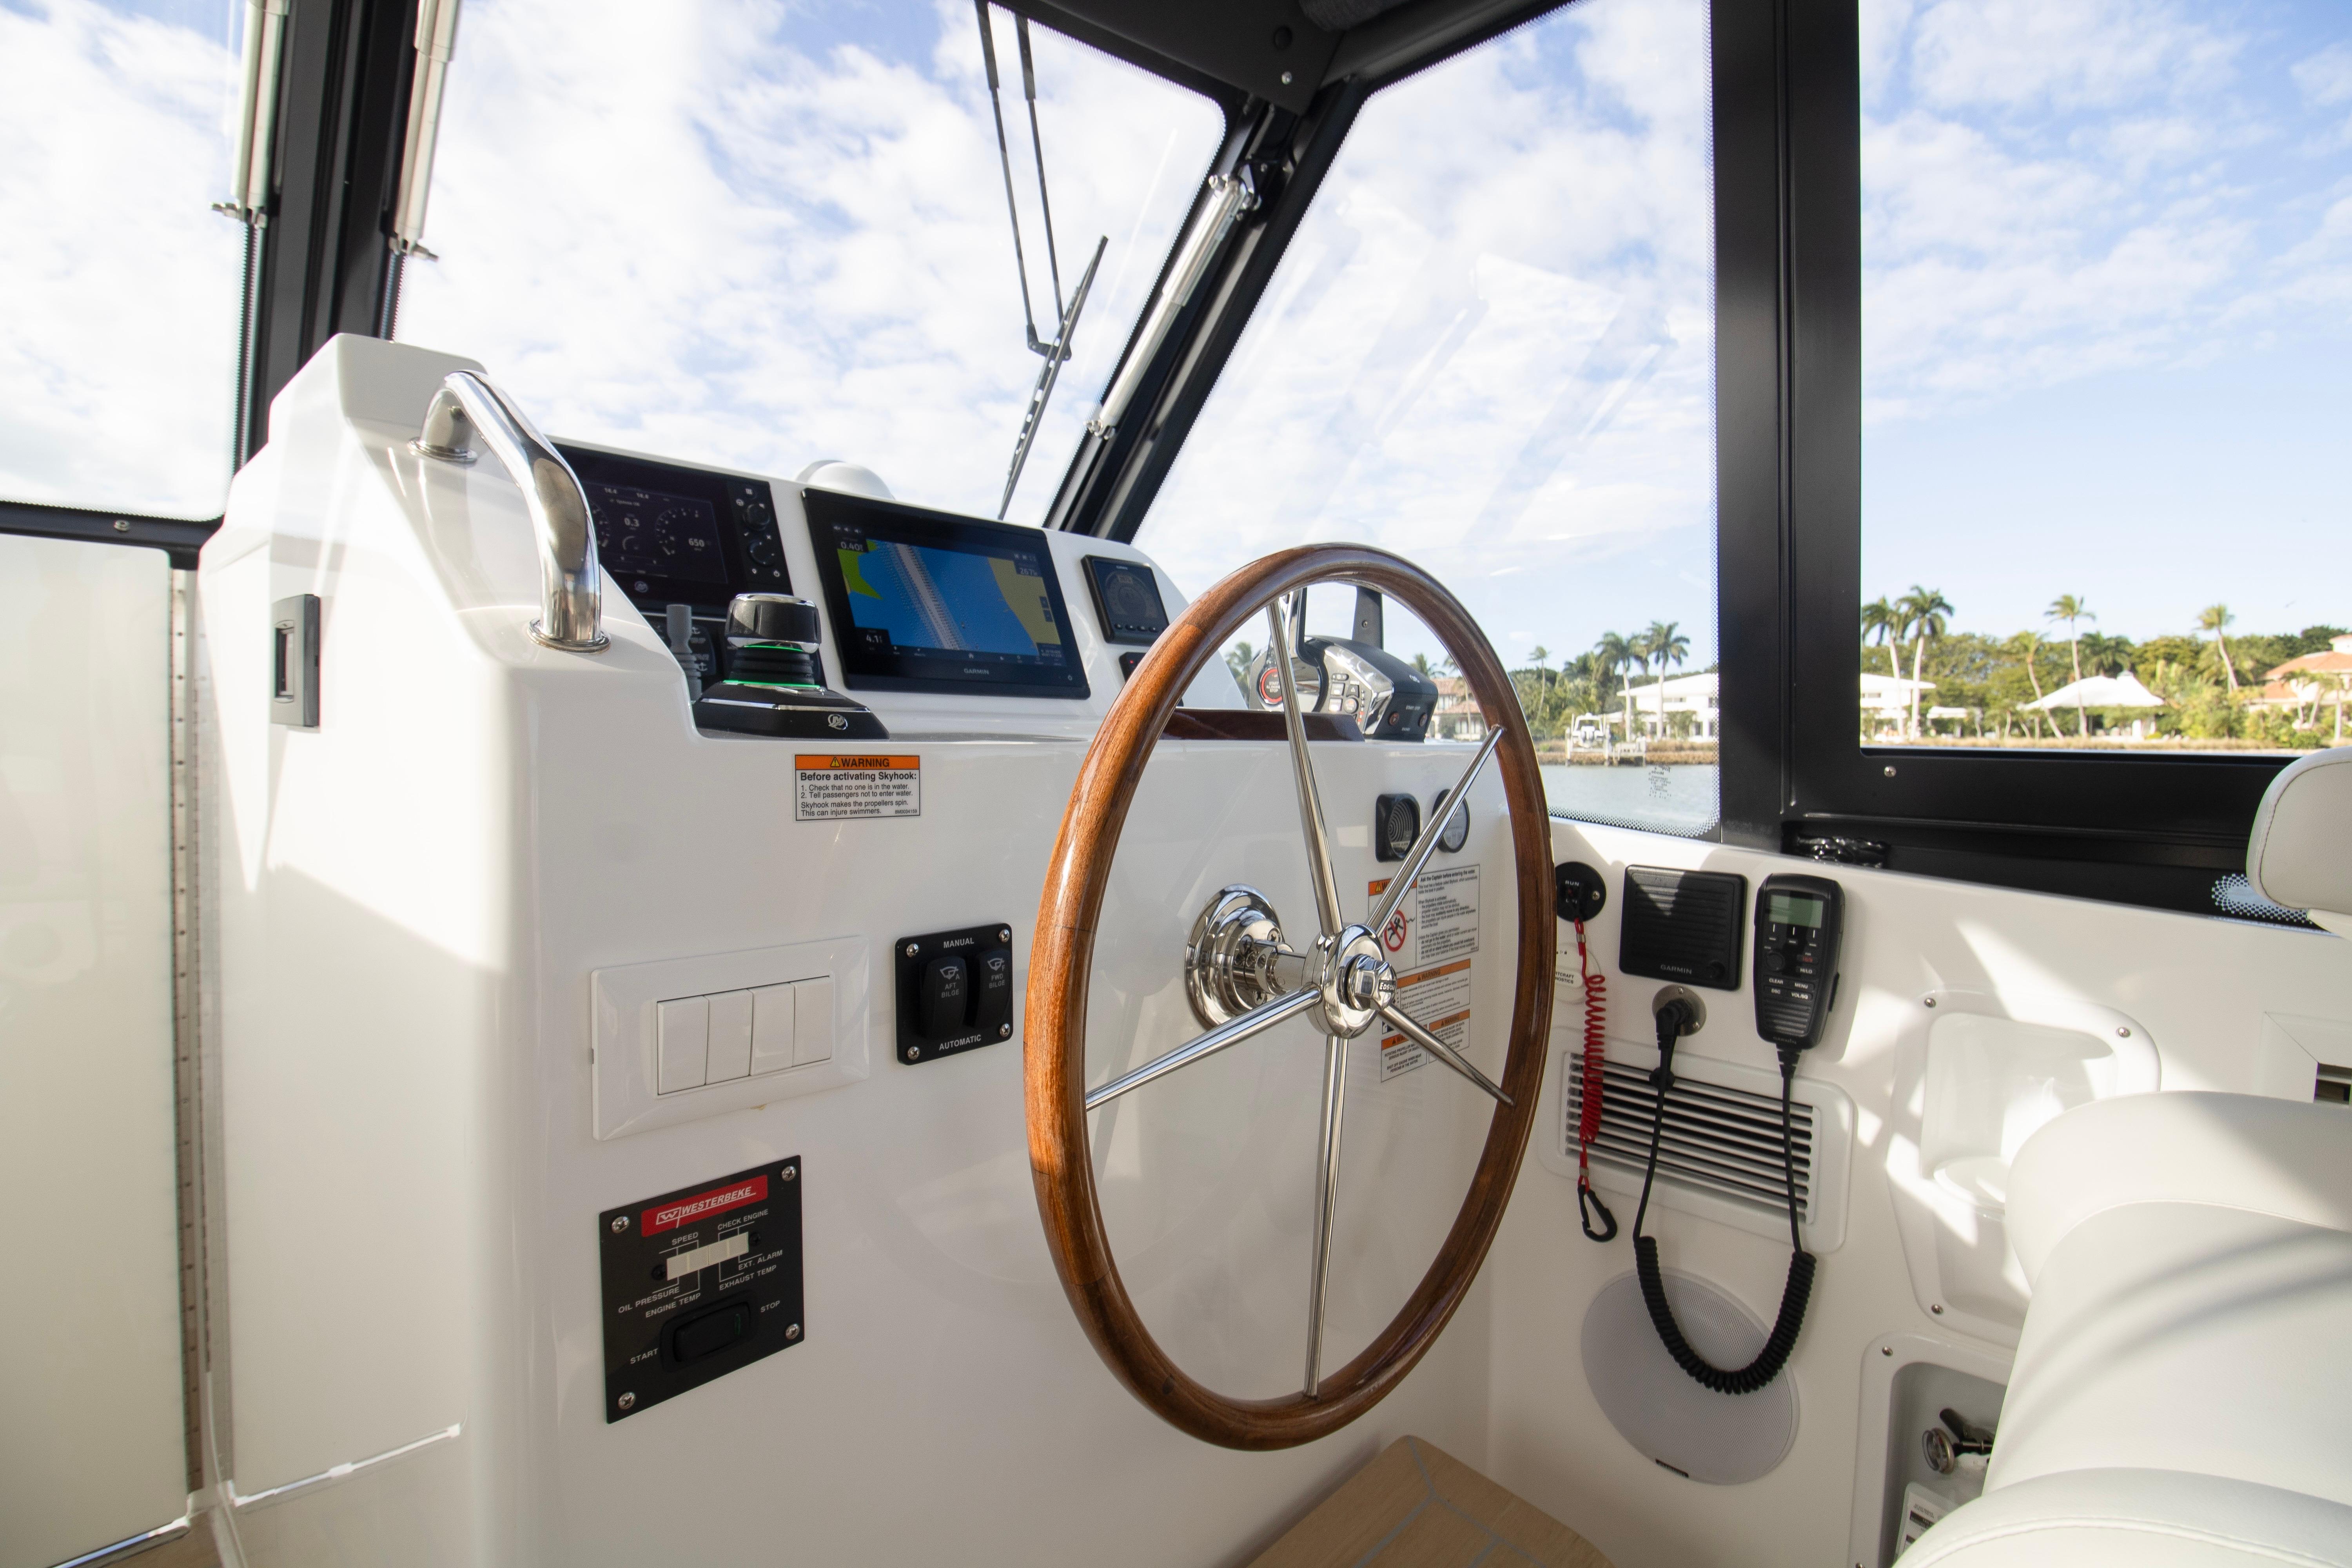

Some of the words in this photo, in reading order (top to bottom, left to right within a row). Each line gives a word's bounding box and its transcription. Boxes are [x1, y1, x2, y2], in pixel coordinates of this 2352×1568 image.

[624, 517, 639, 527] 0.3
[688, 538, 704, 547] 650
[841, 759, 889, 768] WARNING
[800, 773, 831, 781] Before
[833, 772, 876, 782] activating
[878, 772, 916, 781] Skyhook:
[944, 938, 974, 948] MANUAL
[1421, 969, 1440, 980] WARNING
[1661, 964, 1691, 974] GARMIN
[989, 980, 1005, 988] BILGE
[941, 989, 959, 998] BILGE
[939, 1035, 981, 1050] AUTOMATIC
[681, 1187, 751, 1214] WESTERBEKE
[718, 1218, 741, 1230] CHECK
[743, 1209, 768, 1223] ENGINE
[672, 1232, 699, 1245] SPEED
[739, 1261, 755, 1270] EXT.
[757, 1250, 783, 1263] ALARM
[719, 1274, 753, 1290] EXHAUST
[755, 1265, 777, 1278] TEMP
[618, 1304, 633, 1313] OIL
[635, 1287, 679, 1307] PRESSURE
[646, 1302, 676, 1318] ENGINE
[679, 1293, 701, 1306] TEMP
[760, 1301, 780, 1313] STOP
[630, 1348, 658, 1364] START
